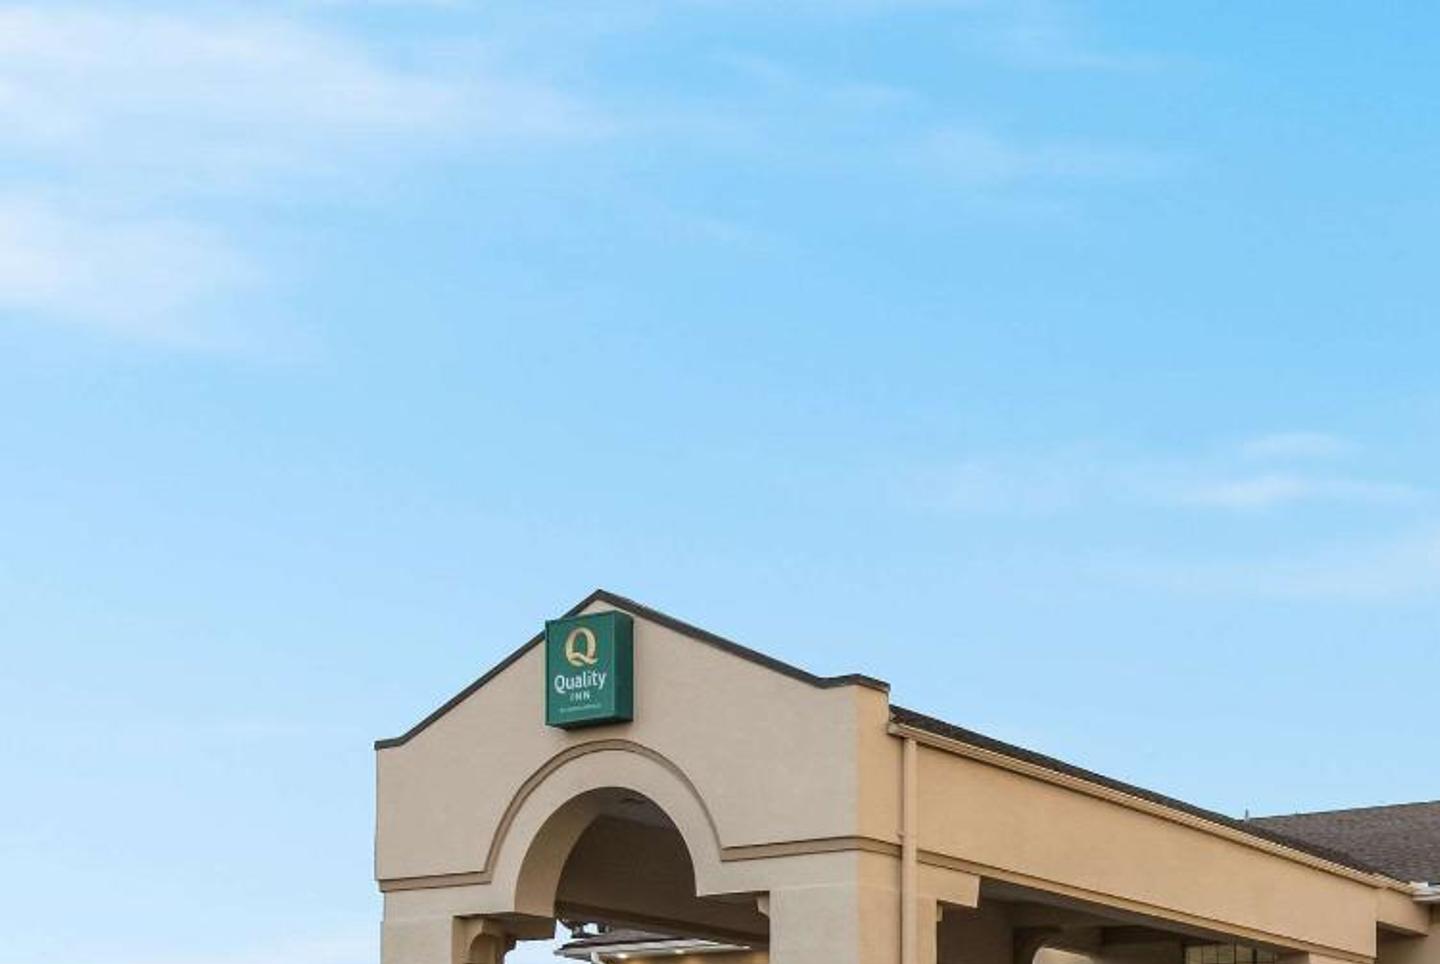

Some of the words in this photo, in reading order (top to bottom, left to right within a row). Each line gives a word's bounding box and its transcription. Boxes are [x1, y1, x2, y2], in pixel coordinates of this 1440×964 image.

[565, 627, 598, 667] Q
[554, 671, 607, 694] Quality
[569, 691, 591, 702] INN
